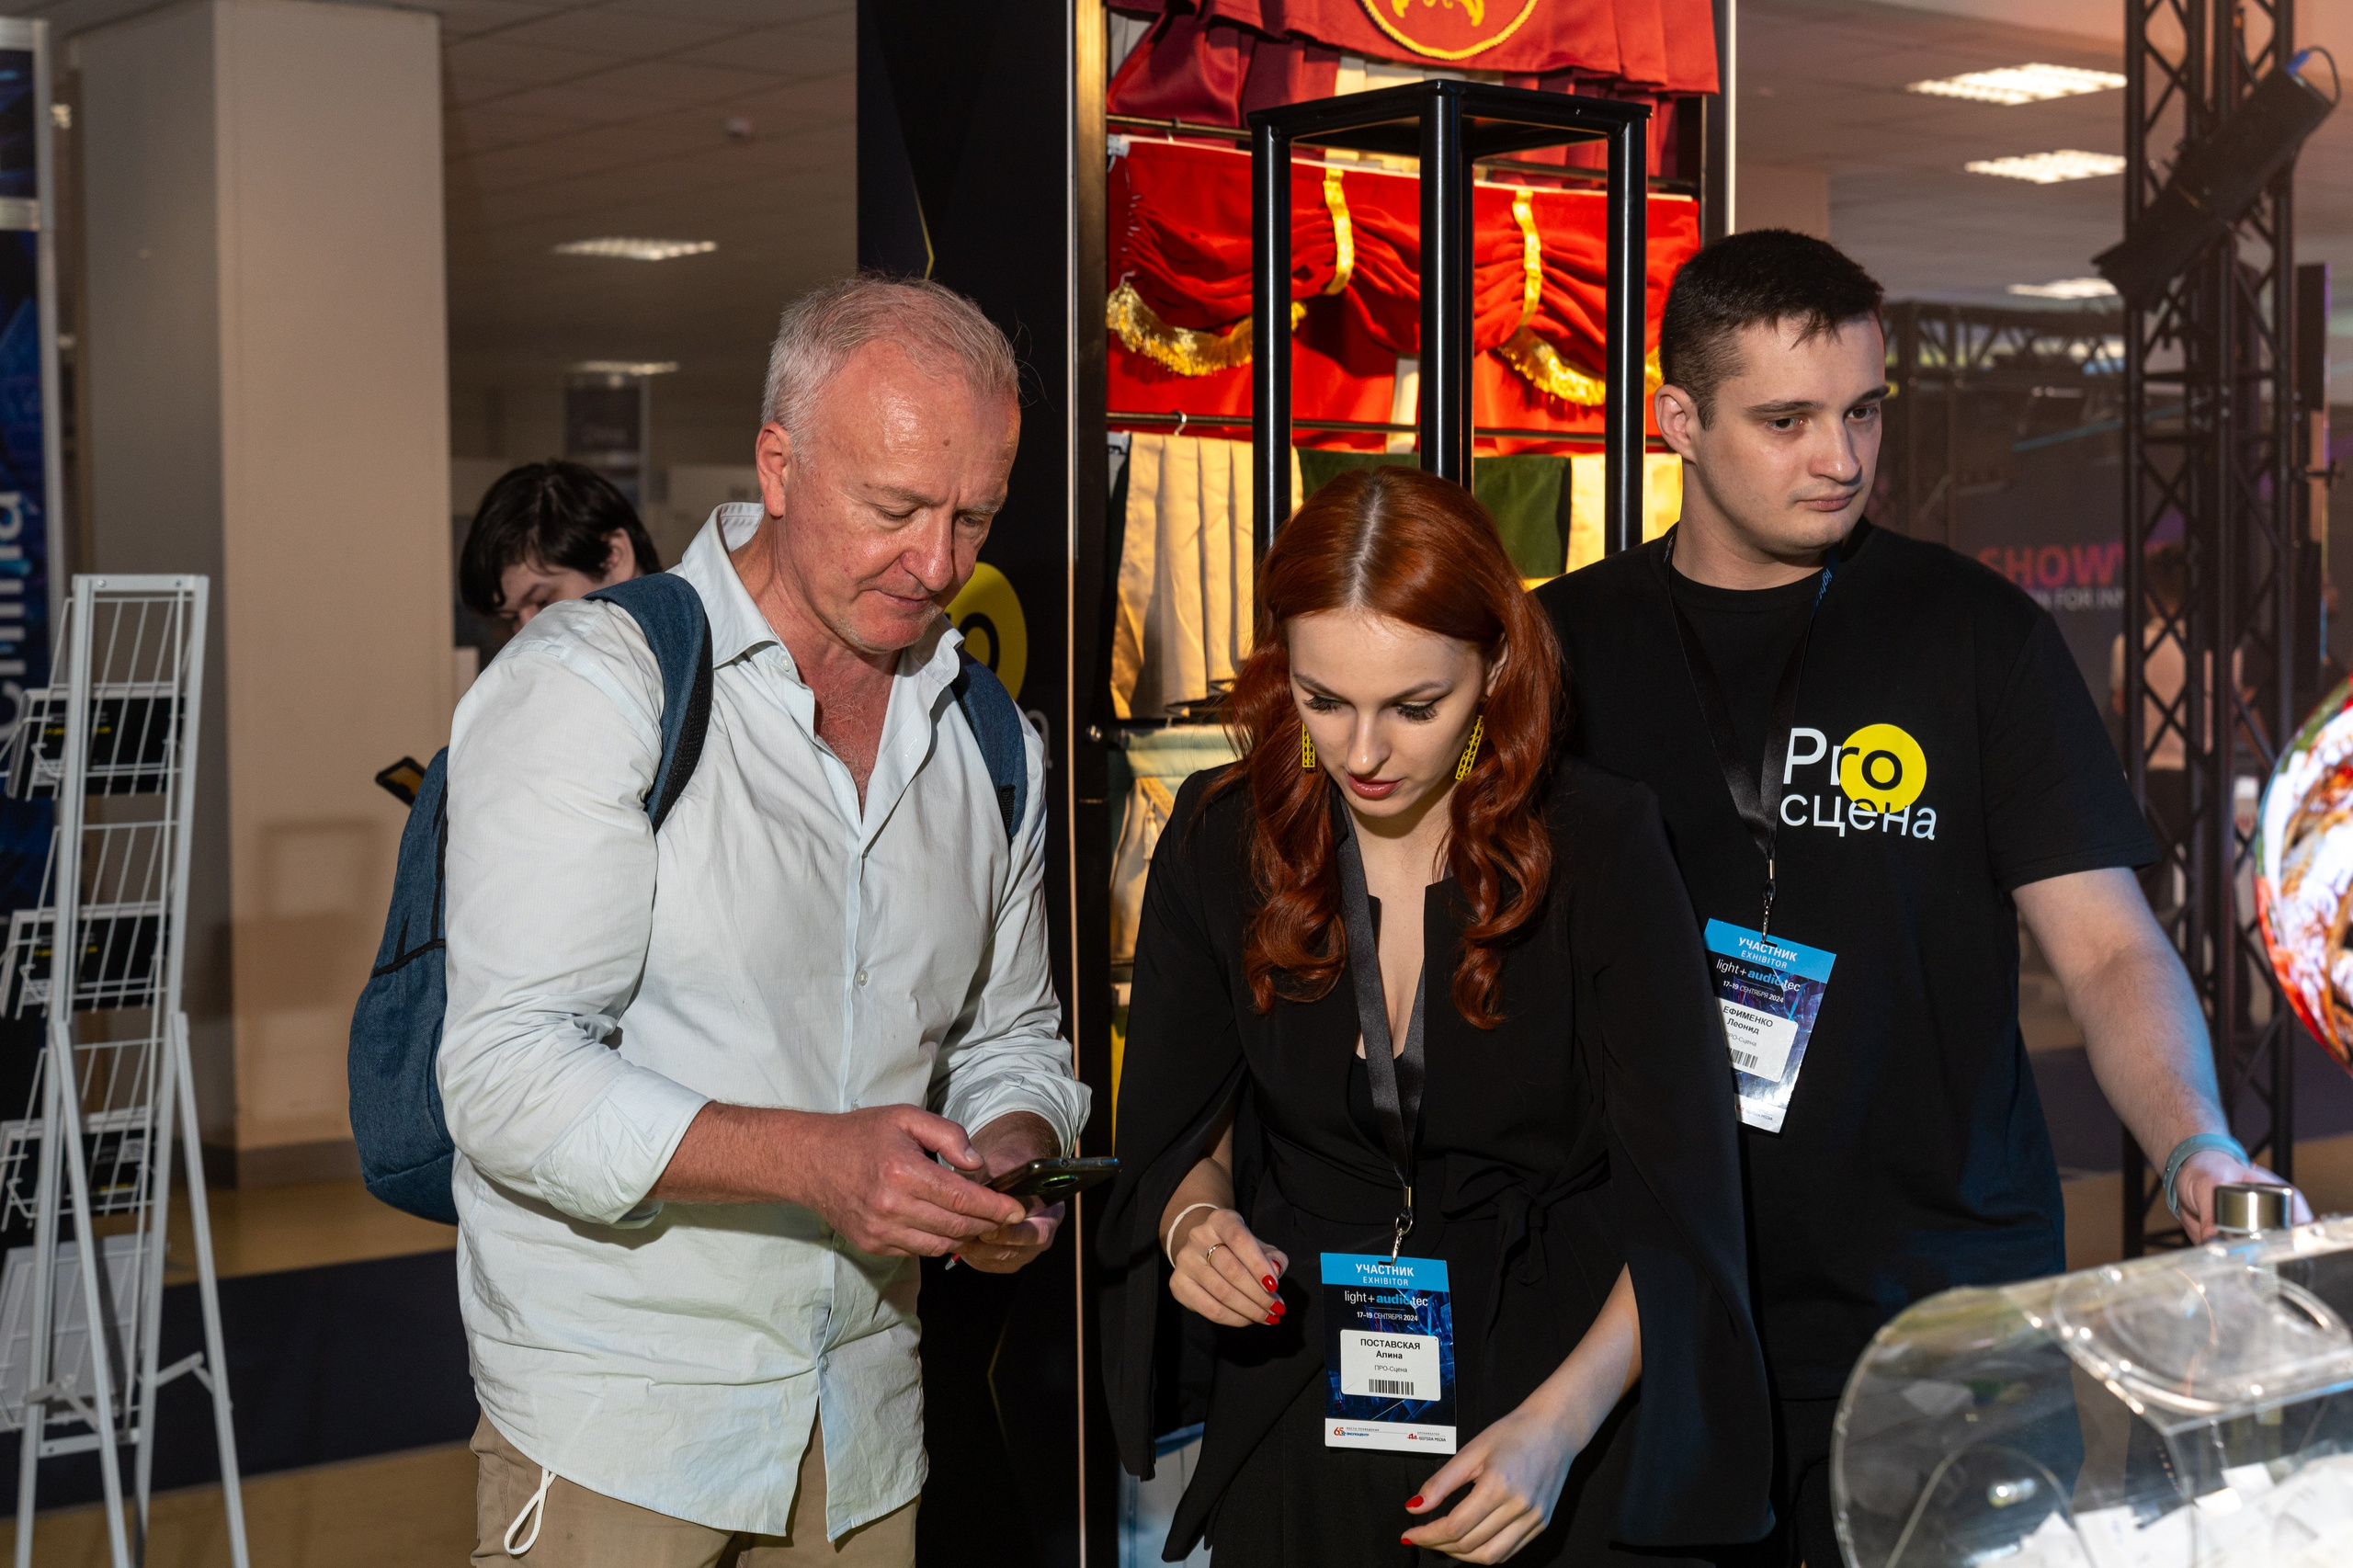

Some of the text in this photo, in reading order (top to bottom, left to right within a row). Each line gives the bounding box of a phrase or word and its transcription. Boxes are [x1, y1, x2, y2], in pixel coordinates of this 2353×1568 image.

[1977, 544, 2124, 587] SHOW
[1783, 727, 1904, 791] Pro
[1779, 794, 1937, 840] сцена
[1738, 937, 1798, 961] УЧАСТНИК
[1741, 949, 1788, 969] EXHIBITOR
[1739, 985, 1769, 998] СЕНТЯБРЯ
[1768, 994, 1784, 1004] 2024
[1722, 1006, 1774, 1028] ЕФИМЕНКО
[1726, 1017, 1760, 1035] Леонид
[1355, 1263, 1415, 1277] УЧАСТНИК
[1362, 1276, 1409, 1286] EXHIBITOR
[1376, 1293, 1410, 1305] audio
[1411, 1296, 1428, 1307] tec
[1373, 1312, 1403, 1321] СЕНТЯБРЯ
[1360, 1338, 1421, 1350] ПОСТАВСКАЯ
[1376, 1350, 1403, 1359] Алина
[1374, 1365, 1408, 1373] ПРО-Сцена
